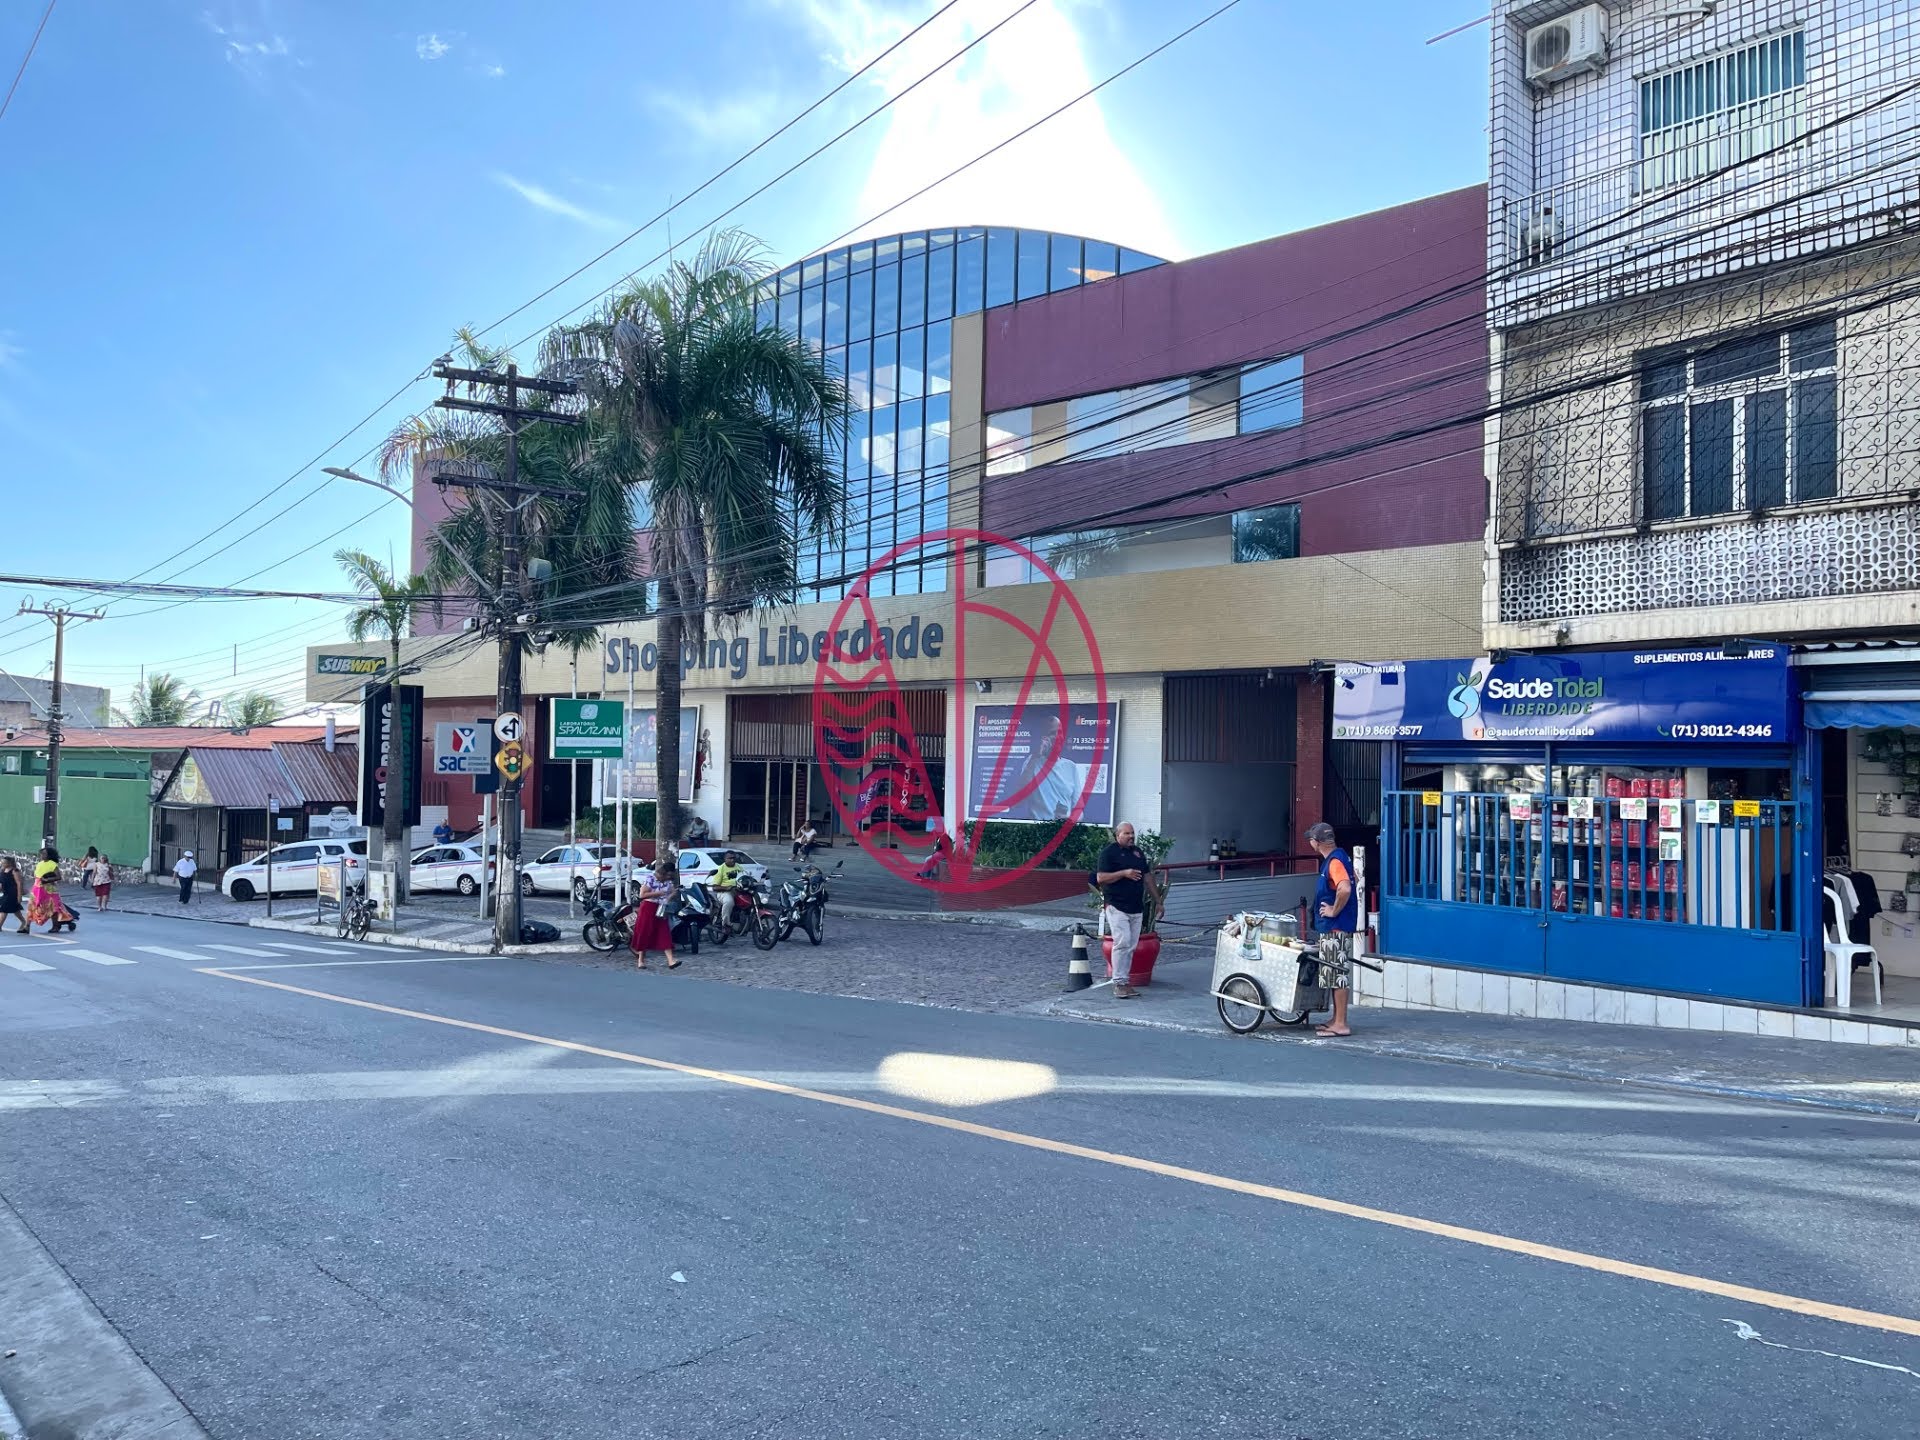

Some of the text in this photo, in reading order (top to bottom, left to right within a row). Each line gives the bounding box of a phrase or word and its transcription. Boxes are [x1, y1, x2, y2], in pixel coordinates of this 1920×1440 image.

[606, 615, 944, 681] Shoping Liberdade
[1633, 649, 1774, 664] SUPLEMENTOS ALIARES
[320, 658, 385, 673] SUBWAY
[1338, 665, 1406, 675] PRODUTOS NATURAIS
[1501, 701, 1594, 716] LIBERDADE
[1345, 725, 1365, 737] (71)
[1487, 726, 1595, 737] @saudetotalliberdade
[1671, 724, 1772, 738] (71) 3012-4346
[438, 756, 467, 772] sac
